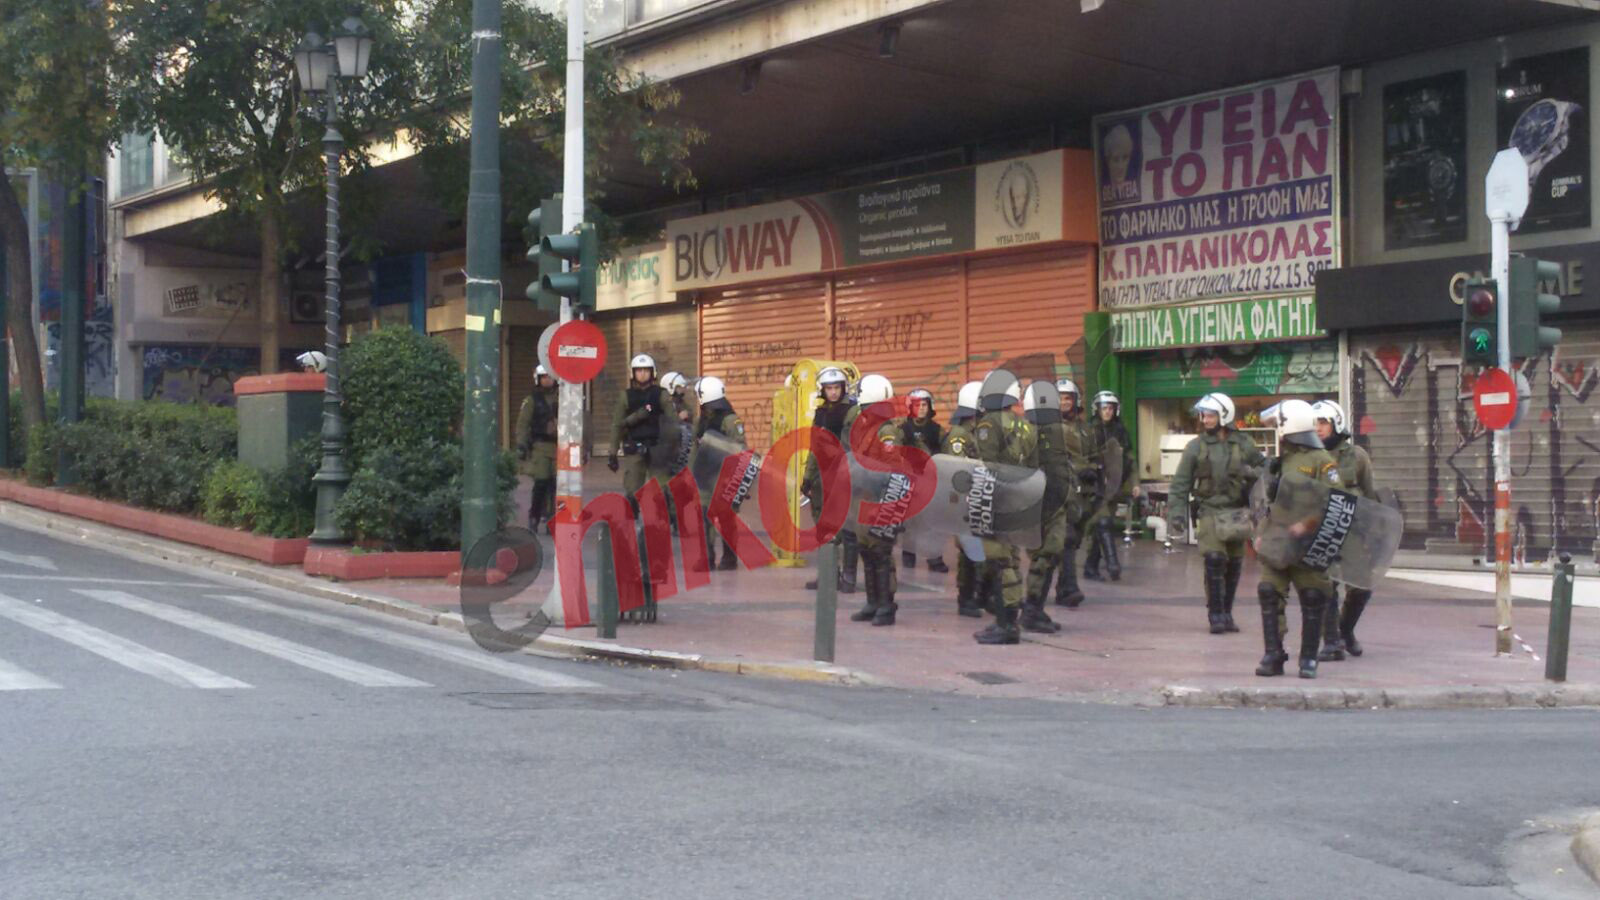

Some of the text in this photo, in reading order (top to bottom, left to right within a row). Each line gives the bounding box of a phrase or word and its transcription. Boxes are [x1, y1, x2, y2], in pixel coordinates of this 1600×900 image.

[1148, 79, 1331, 156] ΥΓΕΙΑ
[1145, 127, 1330, 200] ΤΟ ΠΑΝ
[1552, 185, 1568, 198] CUP
[1102, 181, 1329, 240] ΤΟ ΦΑΡΜΑΚΟ ΜΑΣ Η ΤΡΟΦΗ ΜΑΣ
[675, 214, 801, 282] BIOWAY
[1102, 221, 1332, 282] Κ.ΠΑΠΑΝΙΚΟΛΑΣ
[1112, 309, 1174, 349] ΣΠΙΤΙΚΑ
[1178, 303, 1246, 344] ΥΓΙΕΙΝΑ
[884, 478, 915, 538] POLICE
[980, 470, 999, 535] POLICE
[1317, 501, 1355, 567] POLICE
